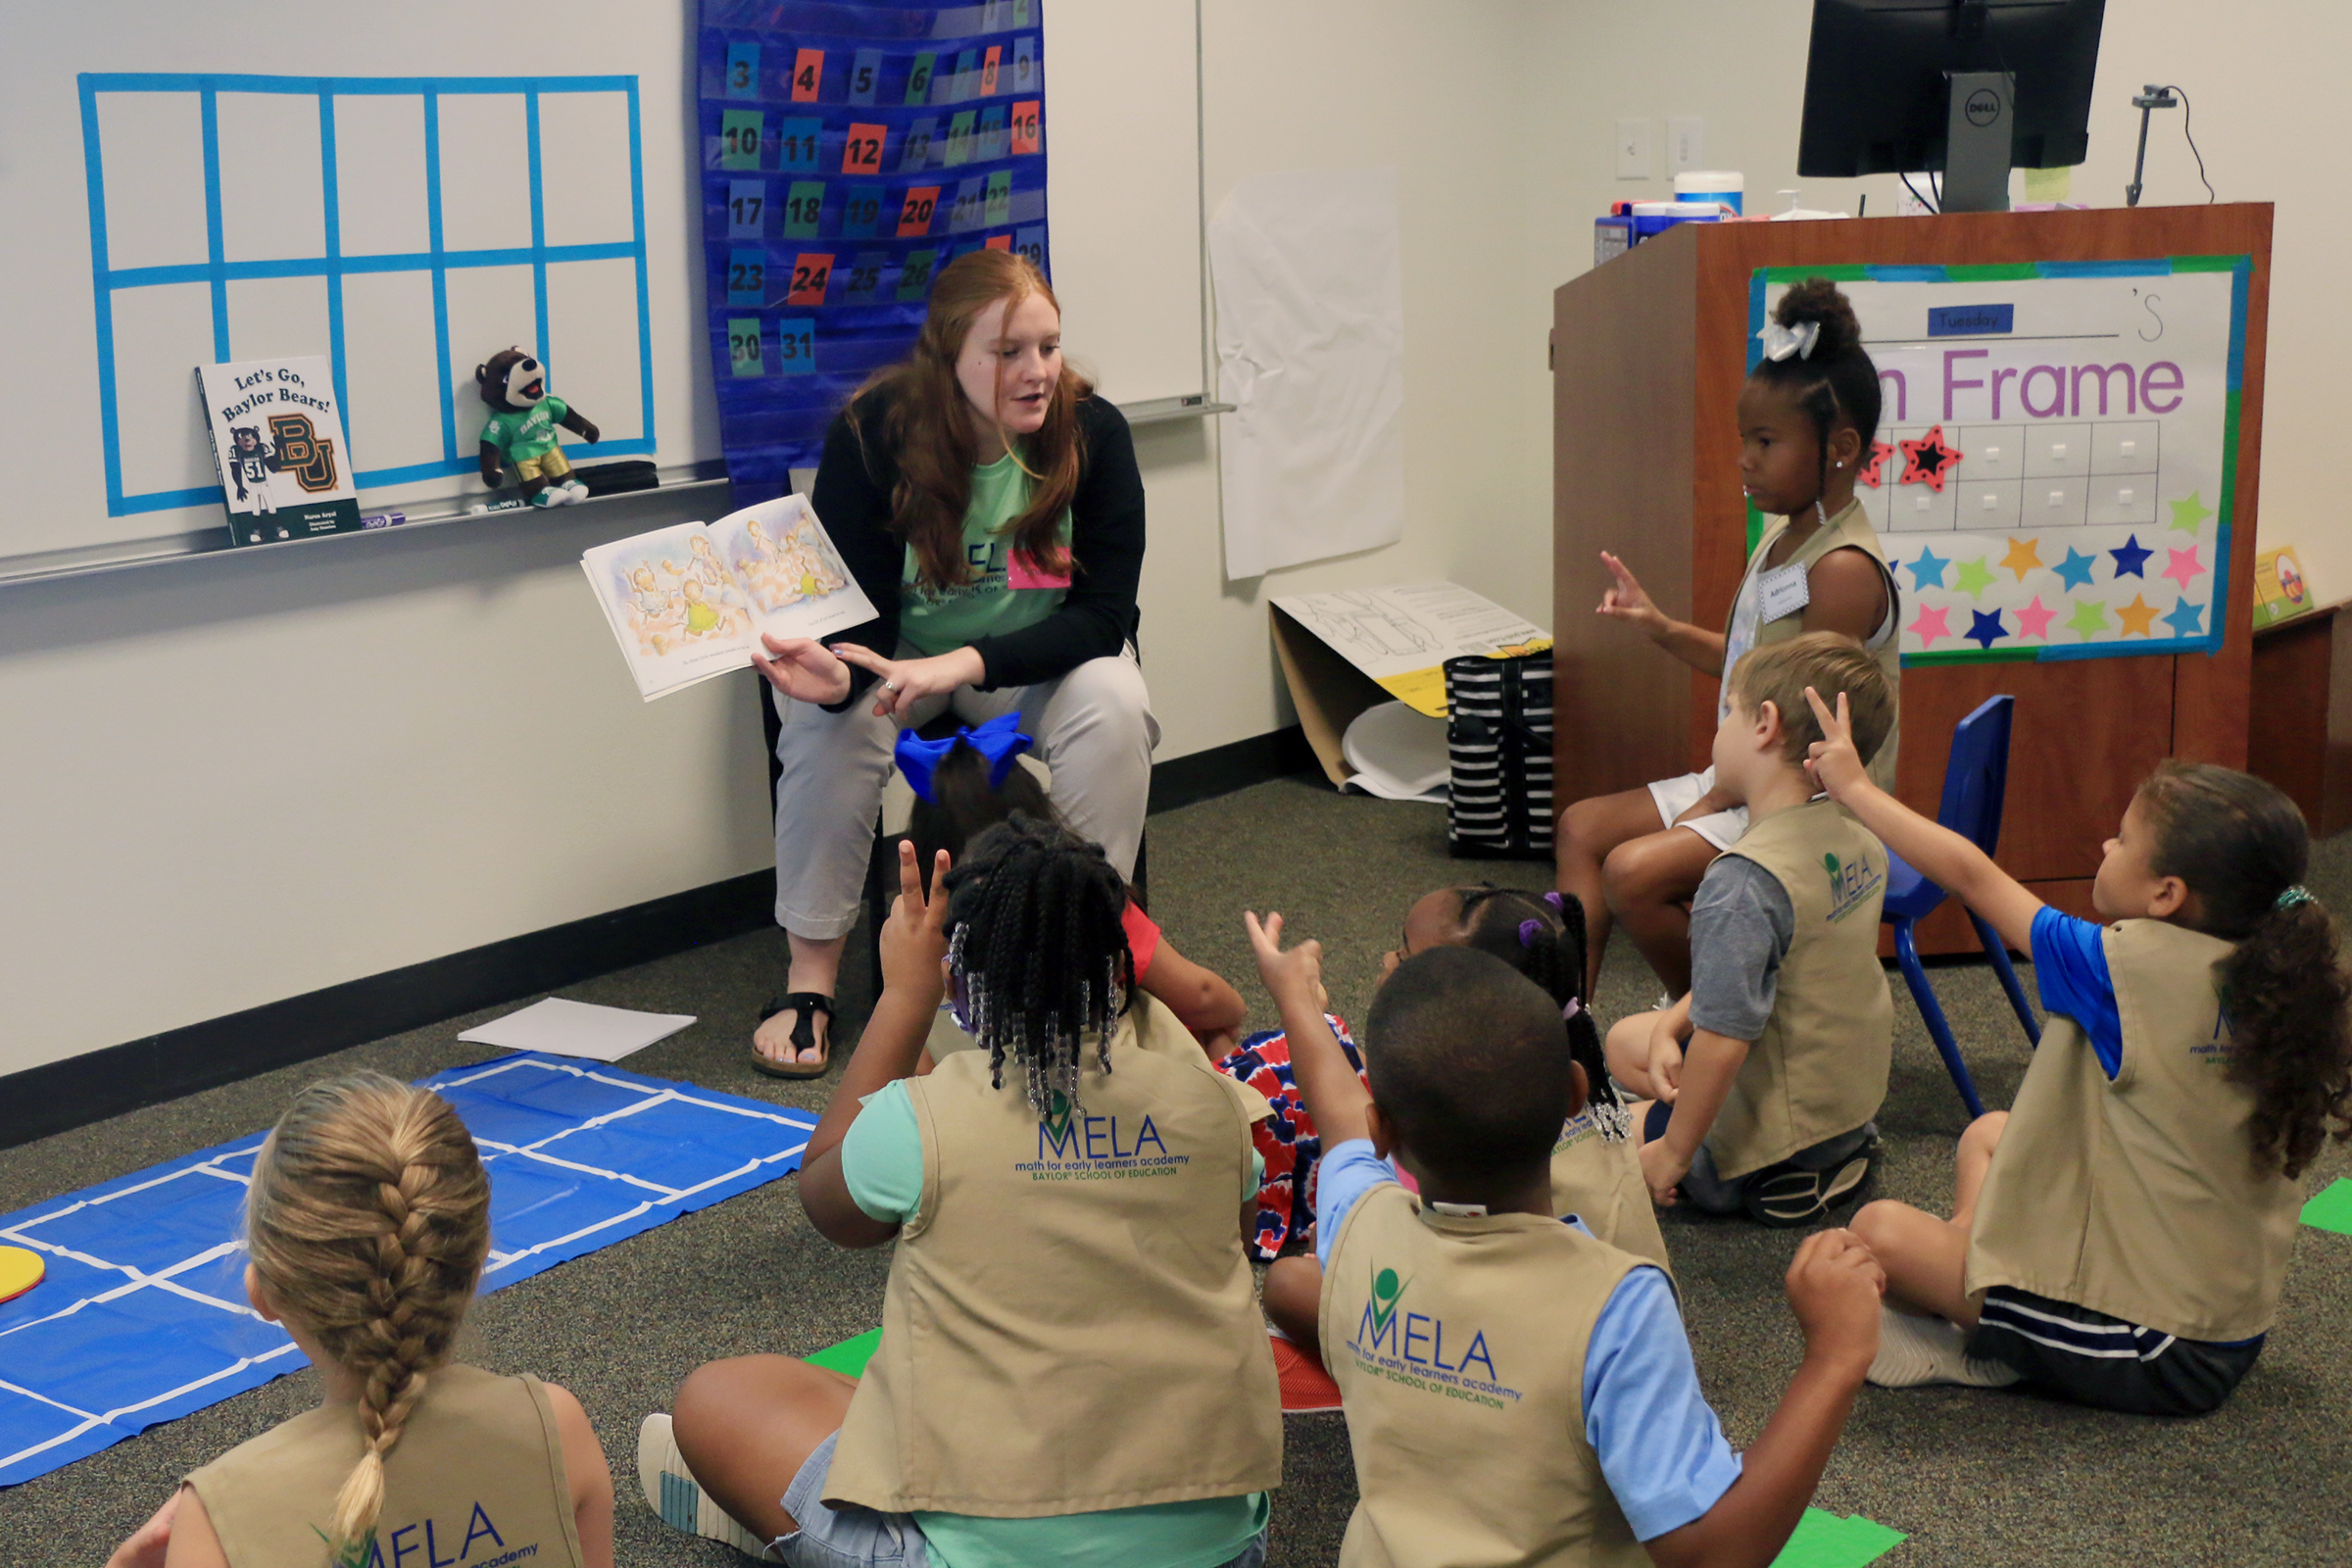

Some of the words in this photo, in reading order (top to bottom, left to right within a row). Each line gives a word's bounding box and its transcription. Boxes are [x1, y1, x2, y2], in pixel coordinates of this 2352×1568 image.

[733, 61, 750, 88] 3
[797, 66, 814, 91] 4
[856, 68, 872, 93] 5
[911, 67, 928, 92] 6
[958, 67, 970, 90] 7
[985, 61, 997, 86] 8
[1018, 55, 1030, 80] 9
[1969, 102, 1996, 113] DELL
[724, 126, 758, 155] 10
[783, 135, 815, 162] 11
[849, 139, 879, 164] 12
[906, 133, 931, 159] 13
[949, 124, 971, 150] 14
[981, 120, 1001, 144] 15
[1013, 115, 1037, 139] 16
[731, 198, 762, 224] 17
[789, 198, 820, 223] 18
[848, 199, 879, 224] 19
[902, 199, 933, 223] 20
[953, 194, 977, 220] 21
[987, 186, 1008, 213] 22
[729, 264, 763, 291] 23
[792, 267, 826, 291] 24
[848, 267, 880, 291] 25
[900, 262, 929, 287] 26
[1939, 313, 1998, 328] Tuesday
[730, 334, 760, 361] 30
[782, 331, 812, 360] 31
[234, 369, 273, 391] Let's
[278, 368, 305, 388] Go,
[1943, 349, 2184, 421] Frame
[221, 392, 274, 422] Baylor
[278, 388, 330, 413] Bears!
[520, 411, 550, 435] BAYLOR
[244, 462, 265, 479] 51
[1039, 1114, 1167, 1159] MELA
[1015, 1161, 1044, 1172] math
[1047, 1160, 1061, 1171] for
[1065, 1159, 1092, 1172] early
[1094, 1158, 1138, 1170] learners
[1140, 1153, 1190, 1166] academy
[1074, 1170, 1112, 1180] SCHOOL
[1114, 1170, 1126, 1179] OF
[1128, 1166, 1177, 1178] EDUCATION
[1357, 1298, 1496, 1381] MELA
[1362, 1348, 1375, 1362] for
[1378, 1356, 1406, 1373] early
[1409, 1362, 1459, 1386] learners
[1462, 1377, 1524, 1402] academy
[1386, 1370, 1427, 1392] SCHOOL
[1429, 1383, 1444, 1395] OF
[1446, 1386, 1504, 1410] EDUCATION
